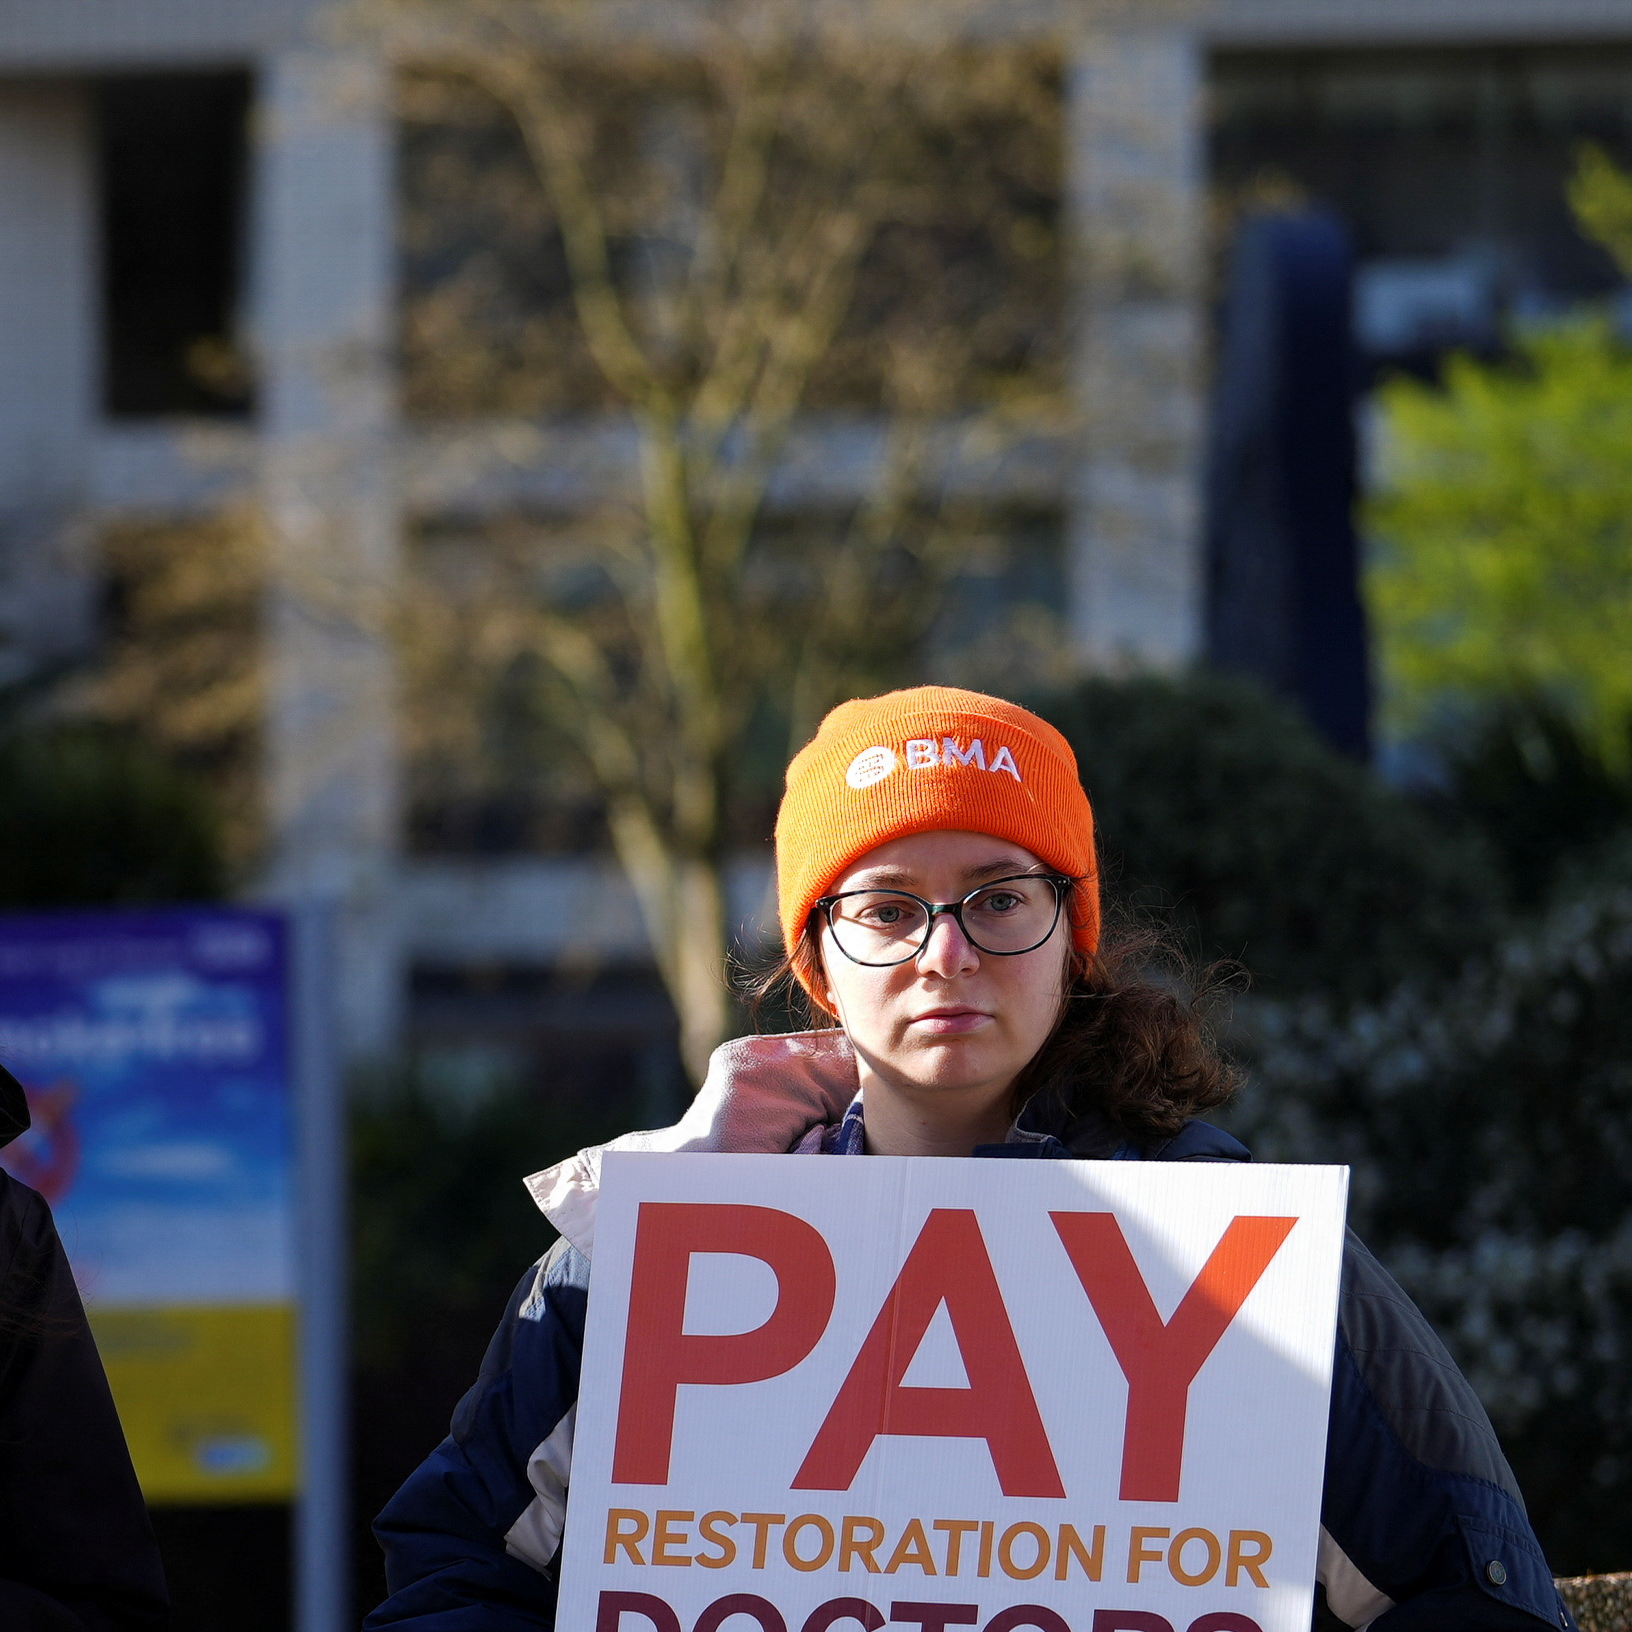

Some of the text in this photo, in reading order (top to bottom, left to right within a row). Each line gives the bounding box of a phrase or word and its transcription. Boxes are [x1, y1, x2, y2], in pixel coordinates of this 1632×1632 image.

[906, 737, 1021, 782] BMA
[610, 1200, 1300, 1503] PAY
[603, 1508, 1273, 1589] RESTORATION FOR
